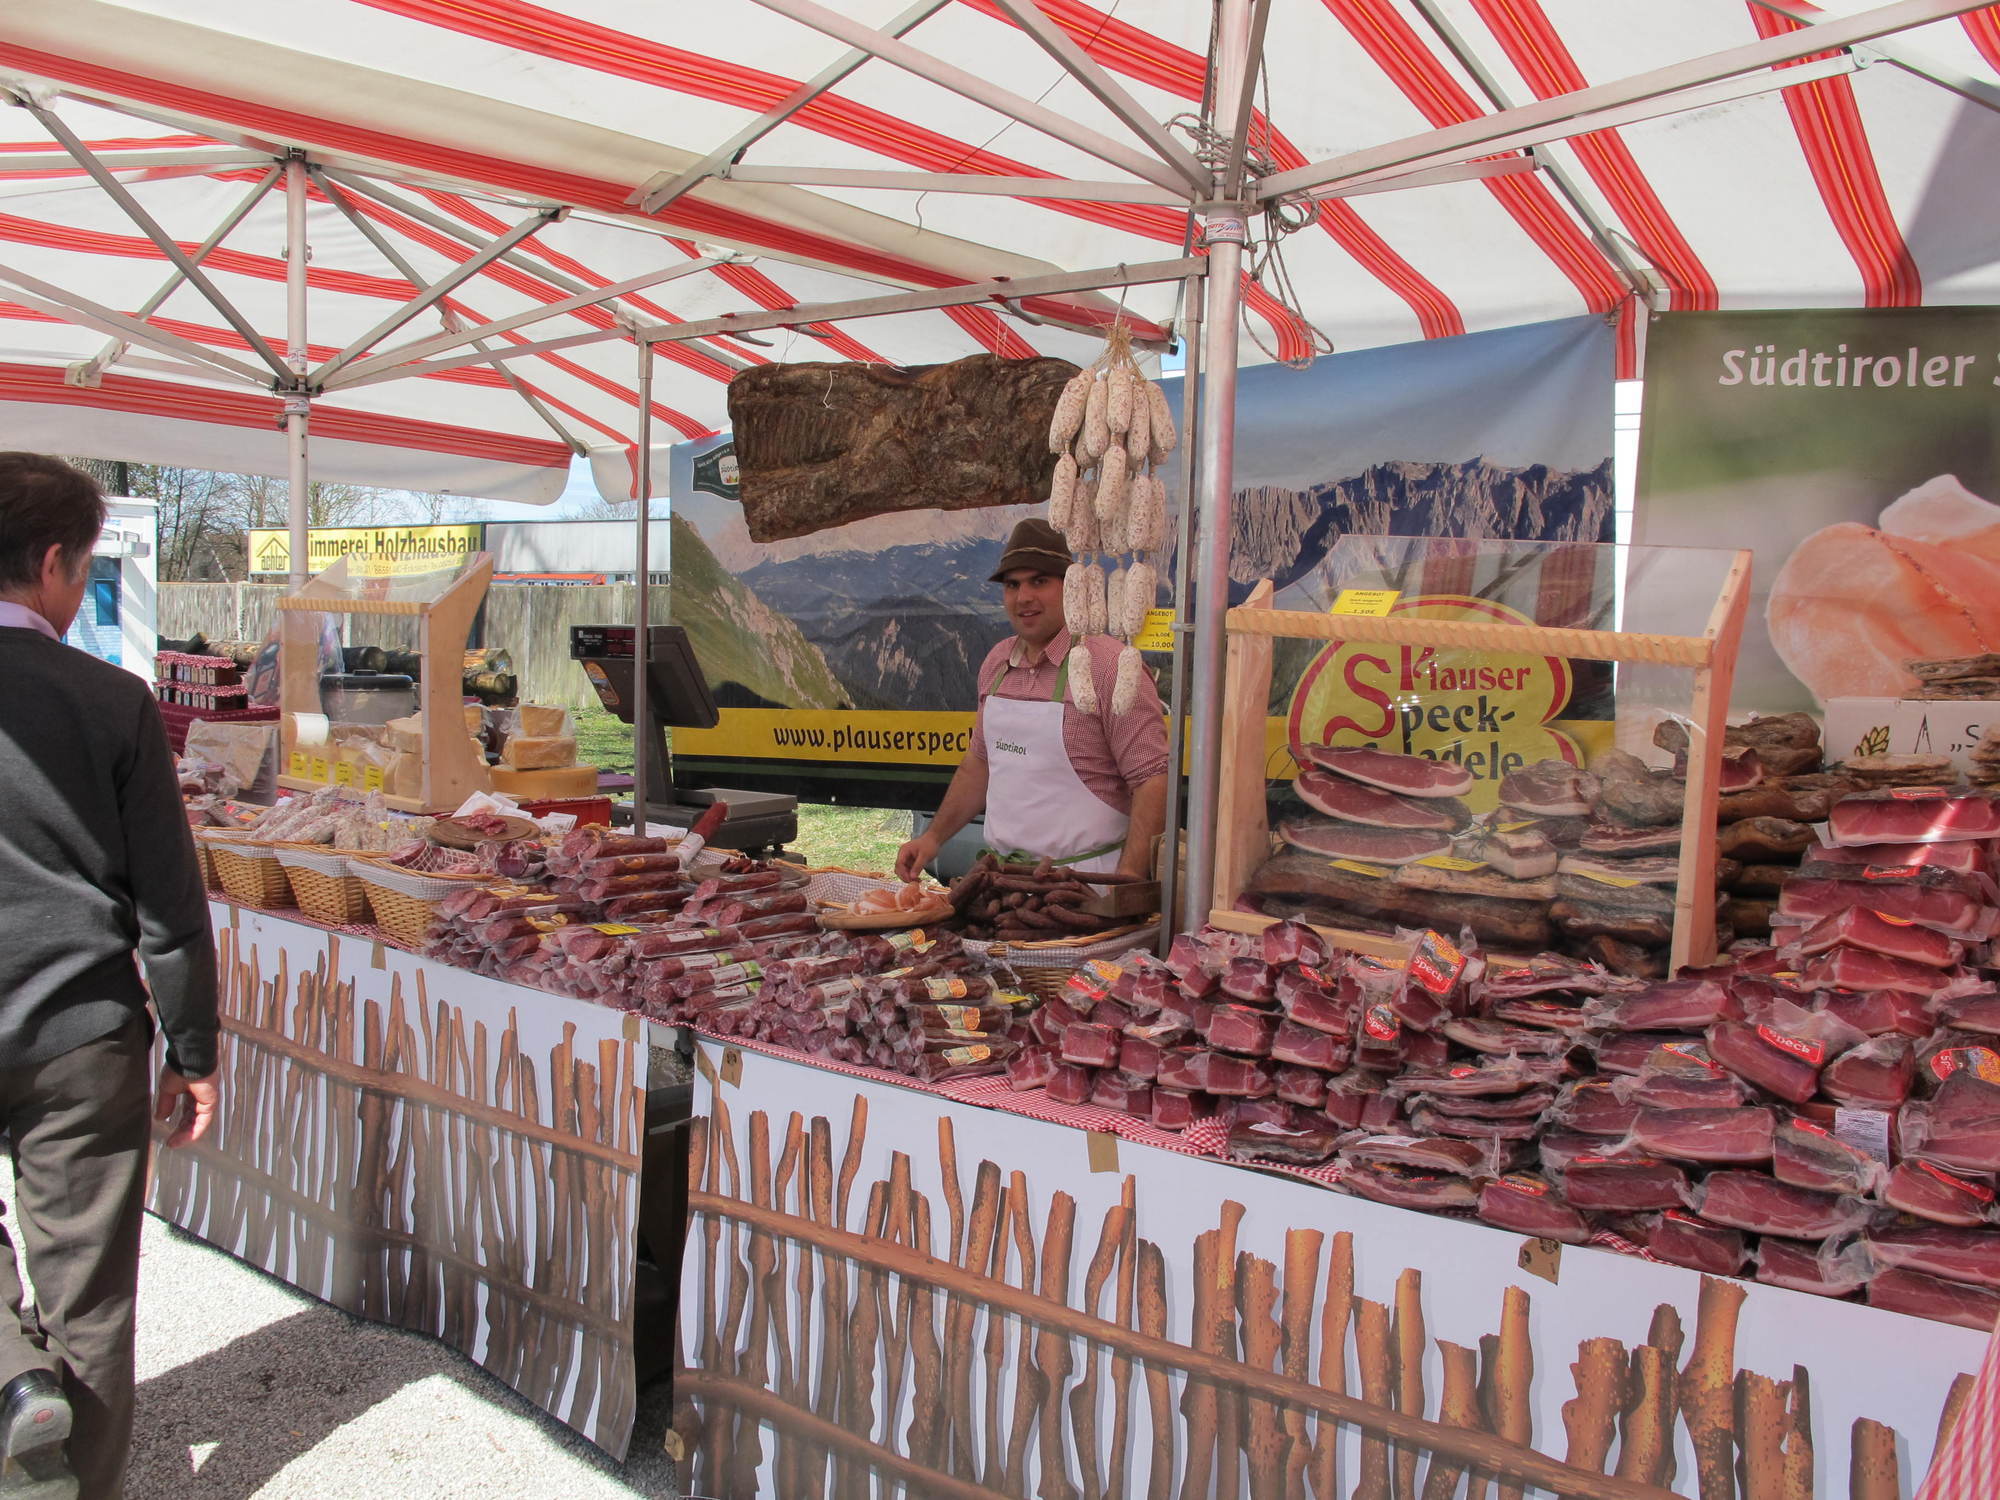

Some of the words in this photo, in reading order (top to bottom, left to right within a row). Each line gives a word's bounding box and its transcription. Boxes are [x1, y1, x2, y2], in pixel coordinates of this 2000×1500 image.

[1718, 344, 1975, 387] Südtiroler
[308, 532, 369, 560] immerei
[375, 529, 478, 562] Holzhausbau
